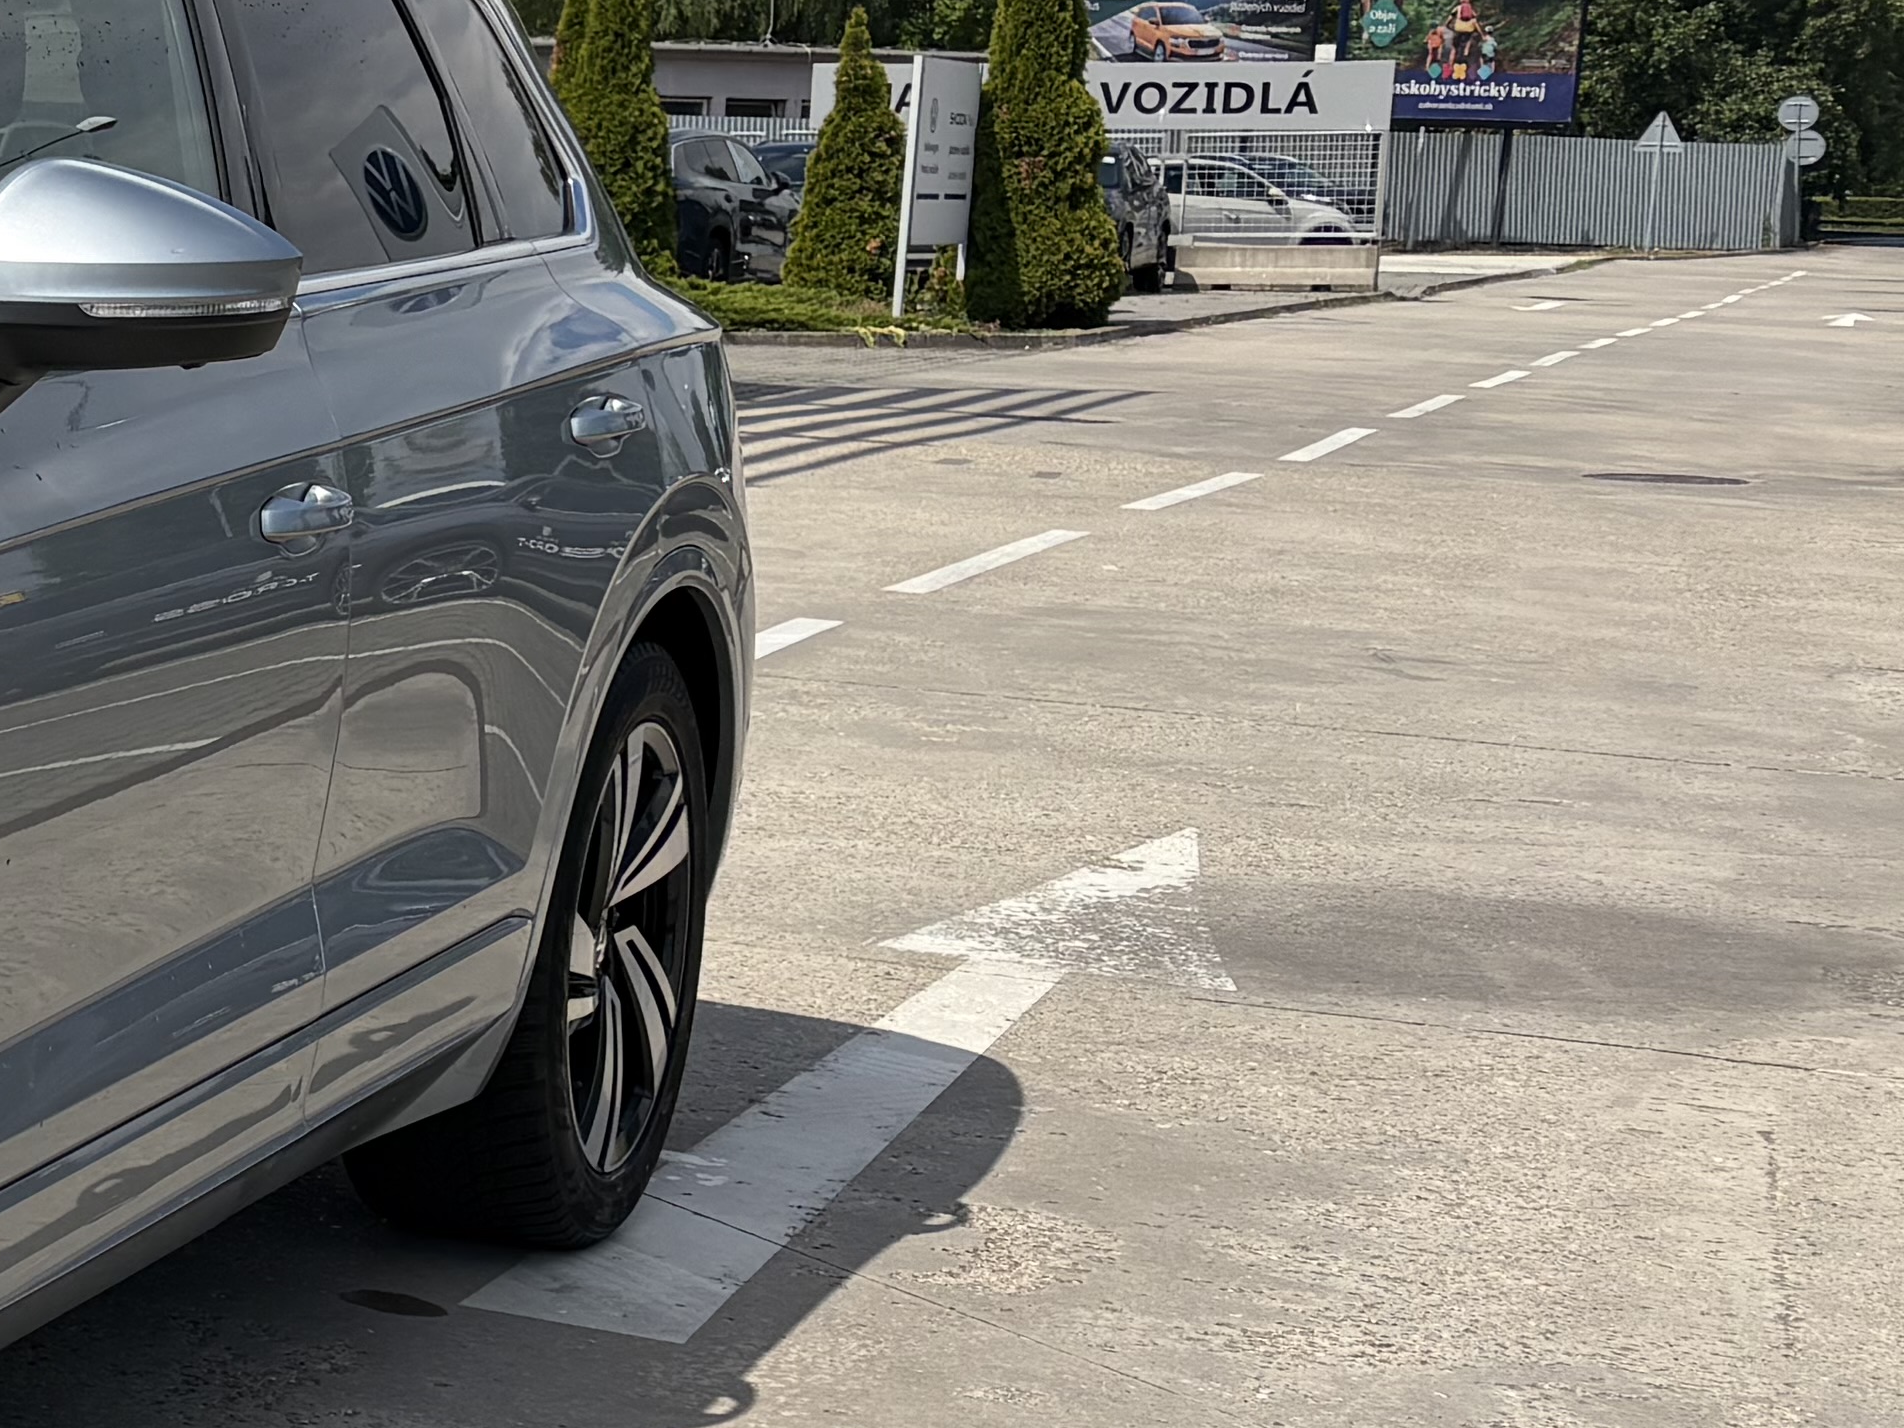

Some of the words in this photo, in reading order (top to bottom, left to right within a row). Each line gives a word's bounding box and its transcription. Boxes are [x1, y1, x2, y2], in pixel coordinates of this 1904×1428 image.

[1369, 9, 1398, 22] Objav
[1100, 69, 1319, 115] VOZIDLÁ
[1511, 82, 1546, 102] kraj
